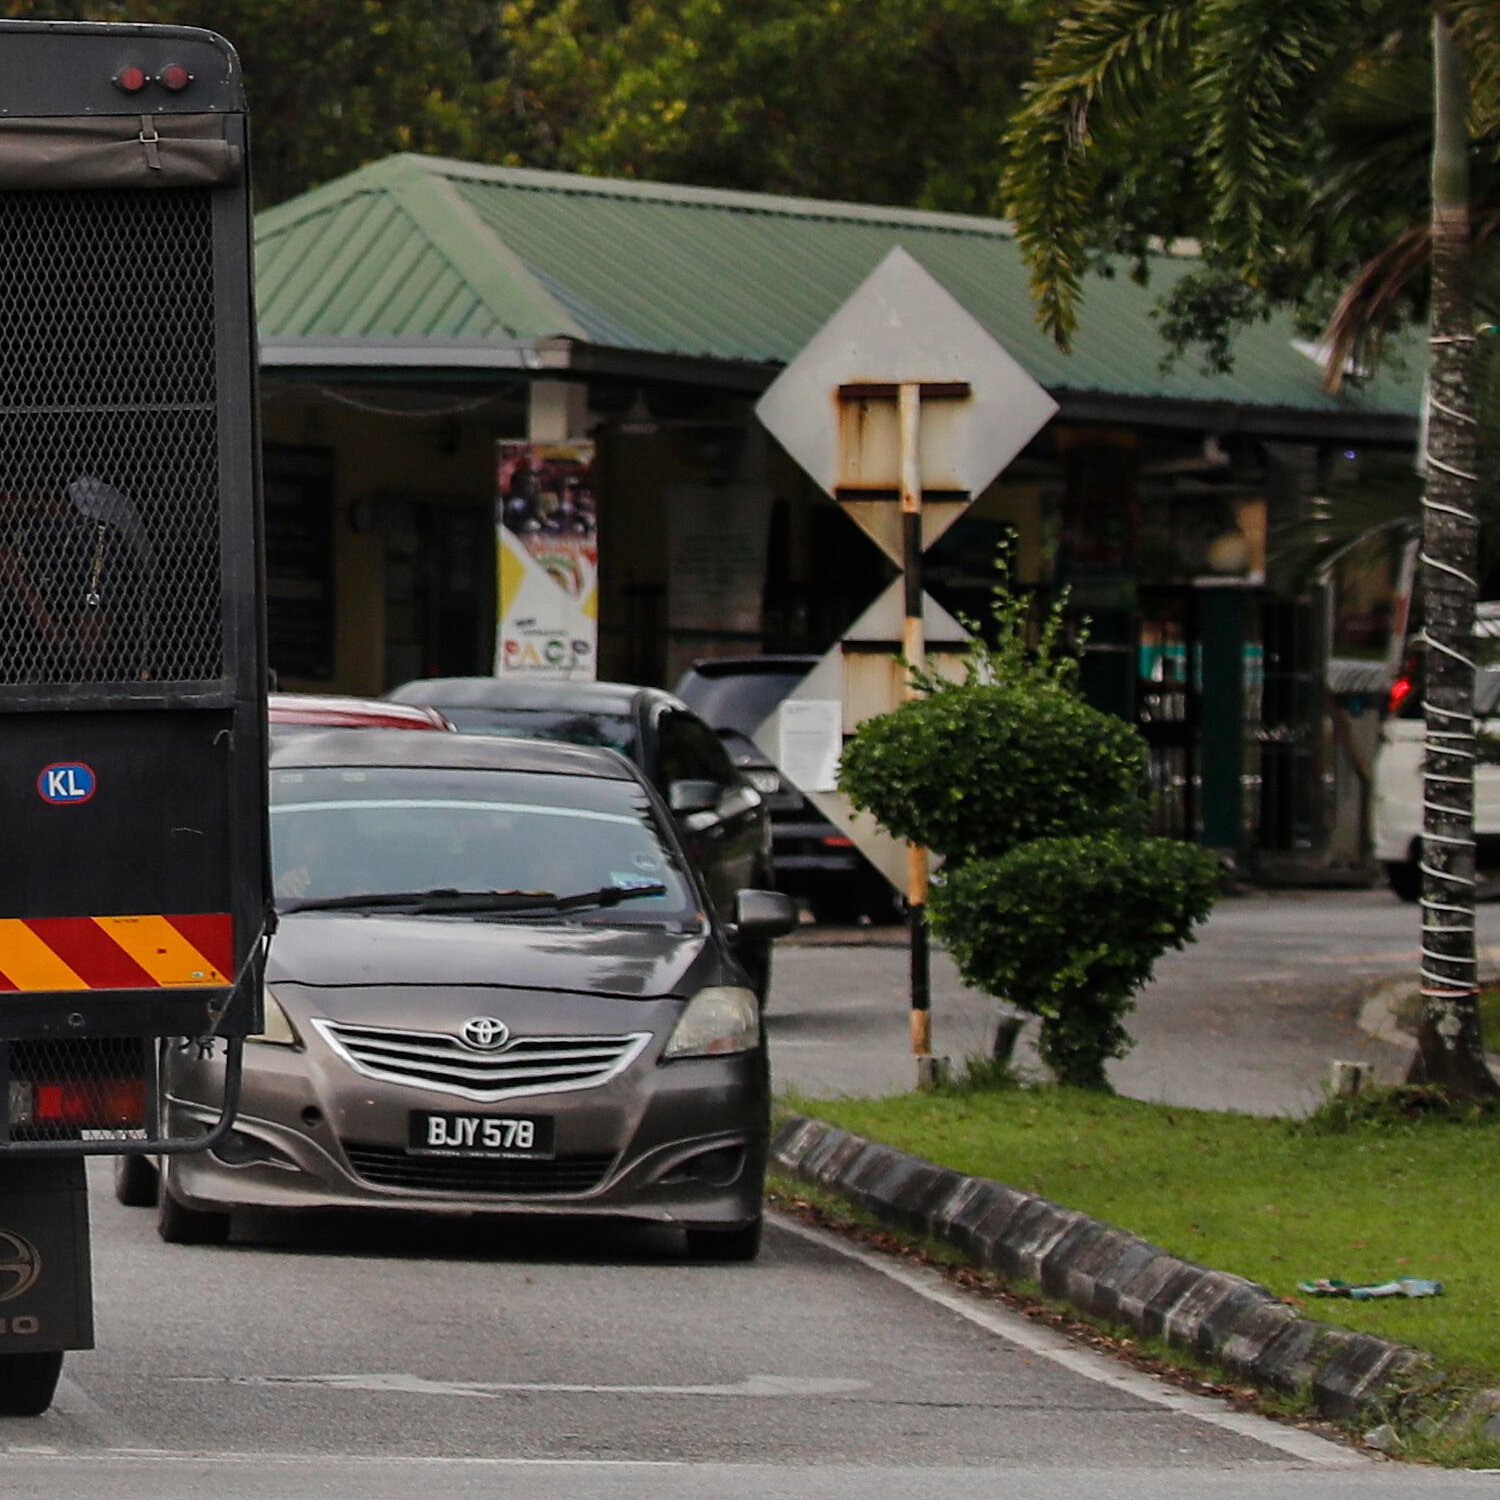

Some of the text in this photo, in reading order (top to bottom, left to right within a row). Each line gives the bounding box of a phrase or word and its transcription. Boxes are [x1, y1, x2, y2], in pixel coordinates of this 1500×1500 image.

[47, 769, 86, 797] KL
[427, 1116, 535, 1148] BJY 578
